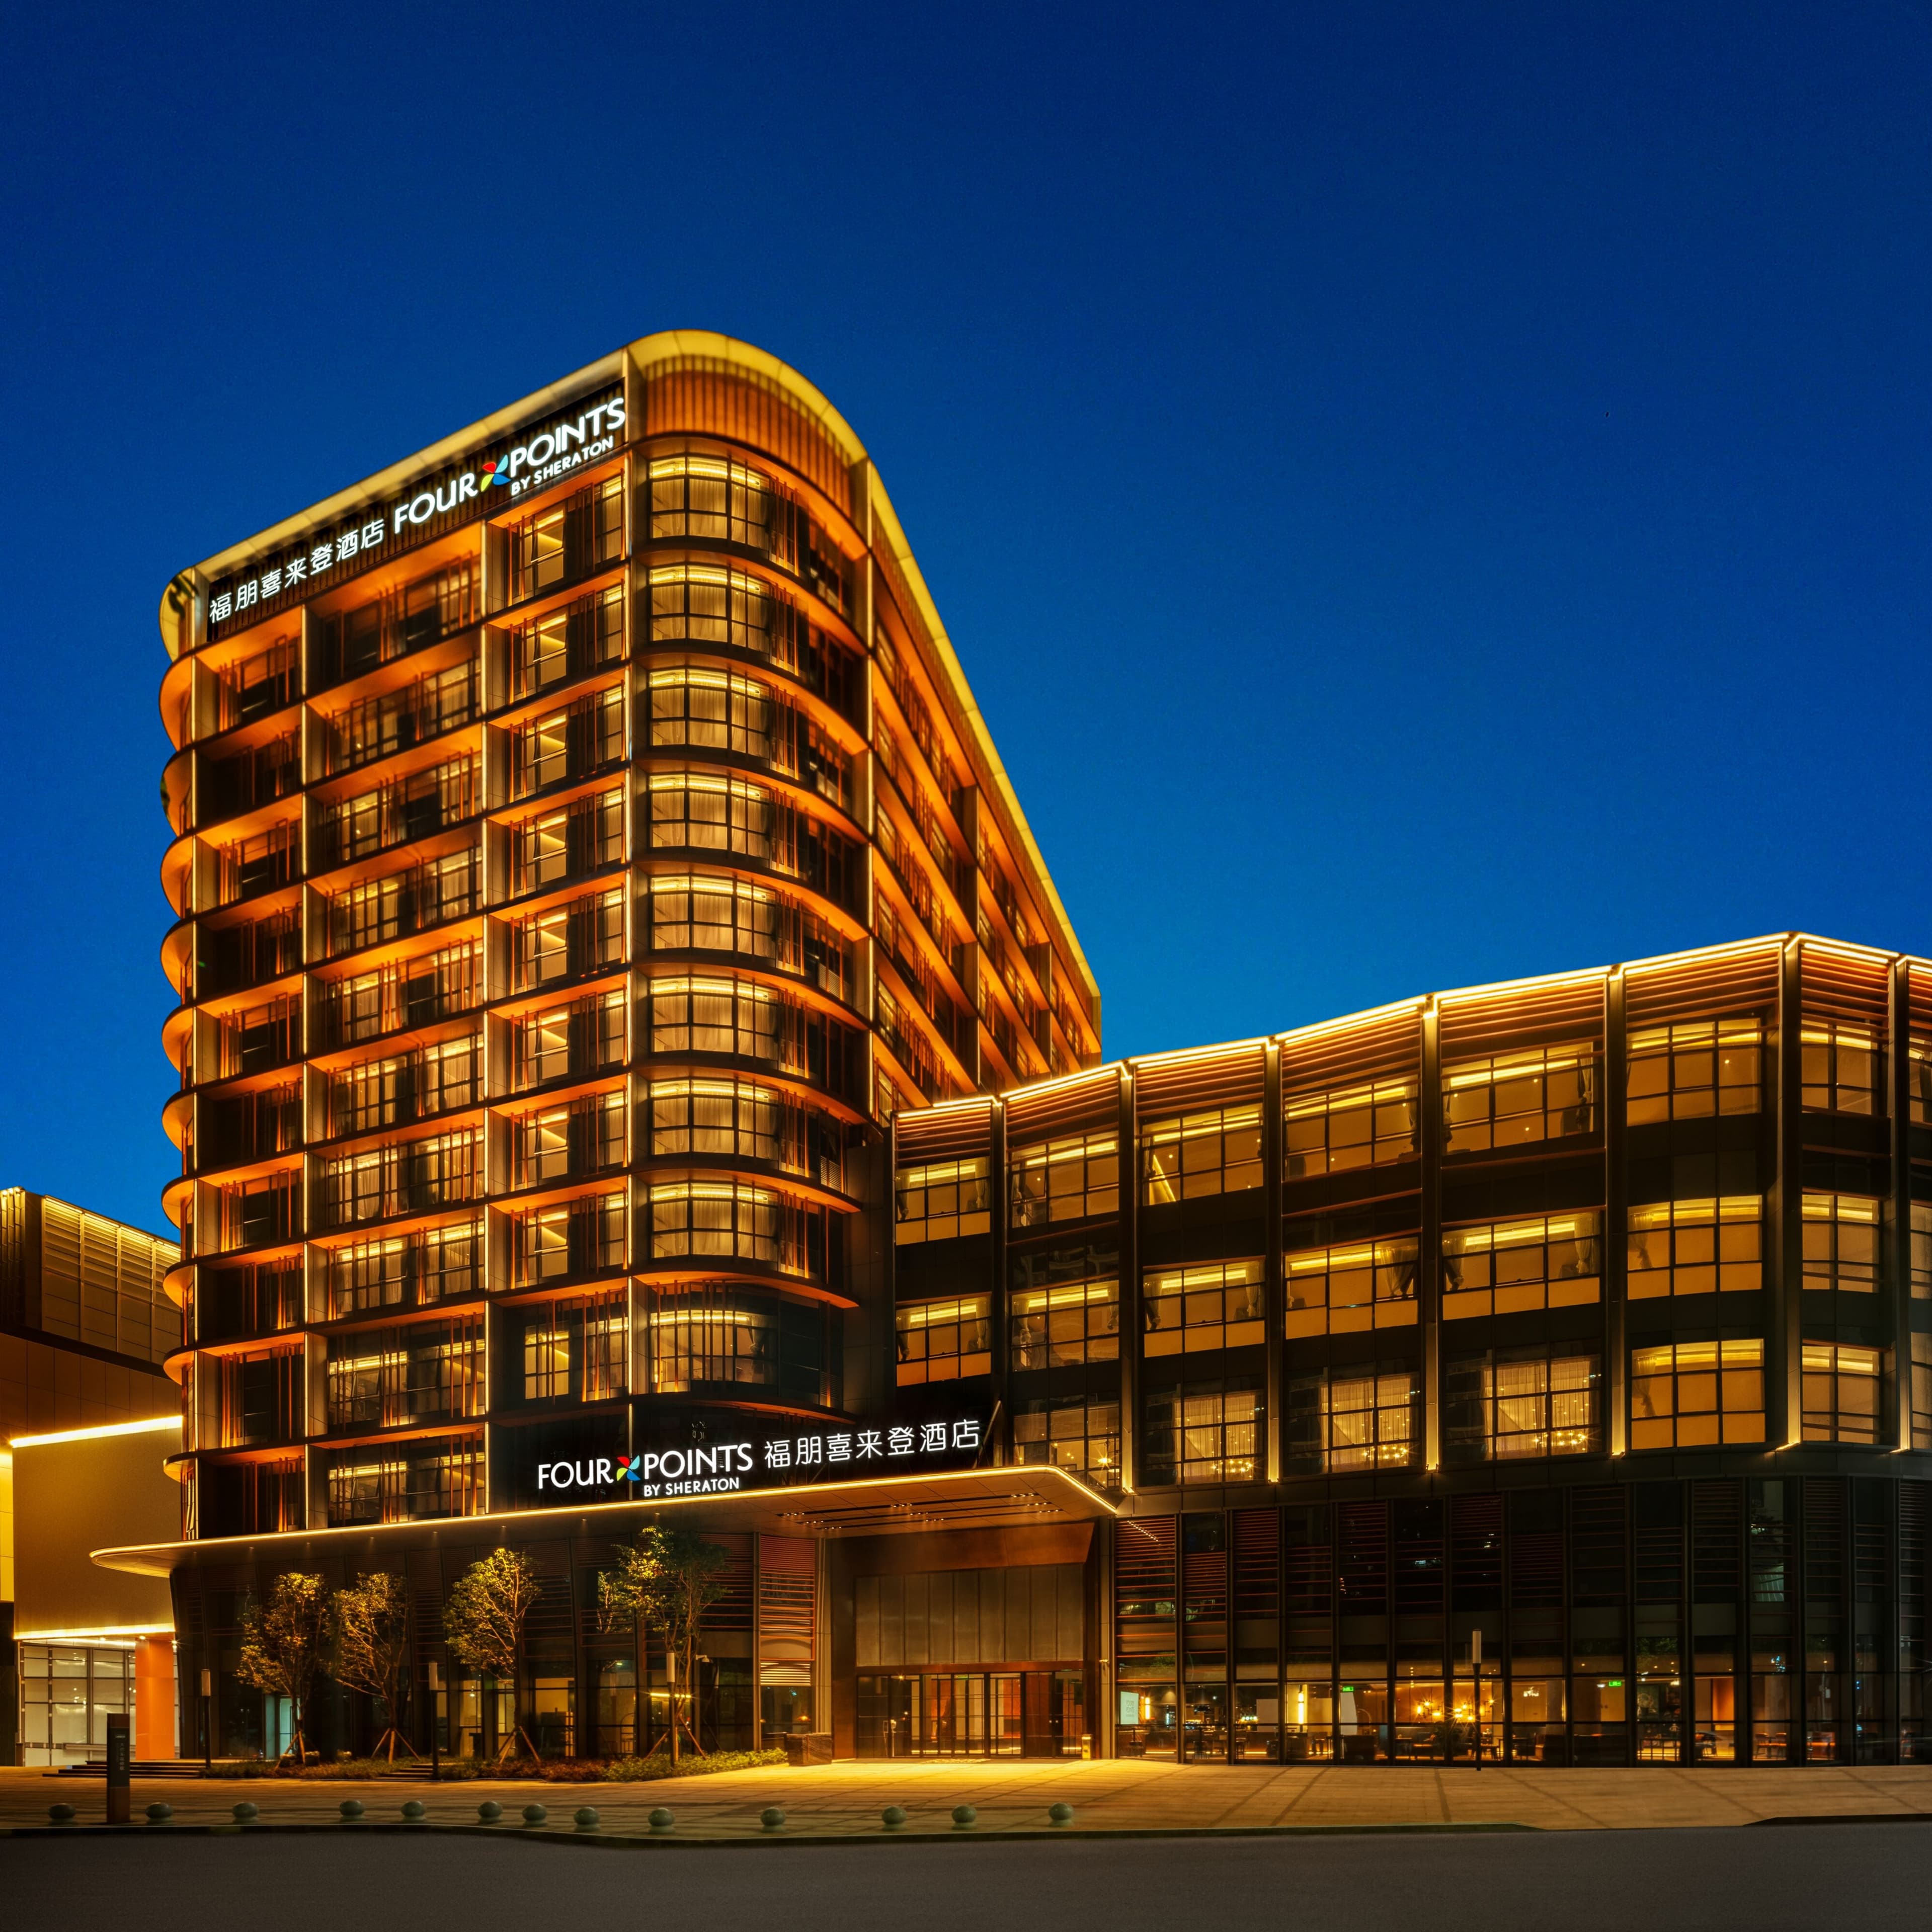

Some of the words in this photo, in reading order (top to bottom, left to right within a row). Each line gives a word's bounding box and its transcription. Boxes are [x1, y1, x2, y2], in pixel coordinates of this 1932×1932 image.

[394, 473, 478, 535] FOUR
[510, 396, 626, 478] POINTS
[511, 475, 531, 497] BY
[533, 435, 614, 486] SHERATON
[209, 518, 385, 624] 福朋喜来登酒店
[538, 1458, 615, 1490] FOUR
[643, 1442, 754, 1480] POINTS
[764, 1419, 980, 1469] 福朋喜来登酒店
[643, 1483, 661, 1497] BY
[665, 1477, 740, 1496] SHERATON
